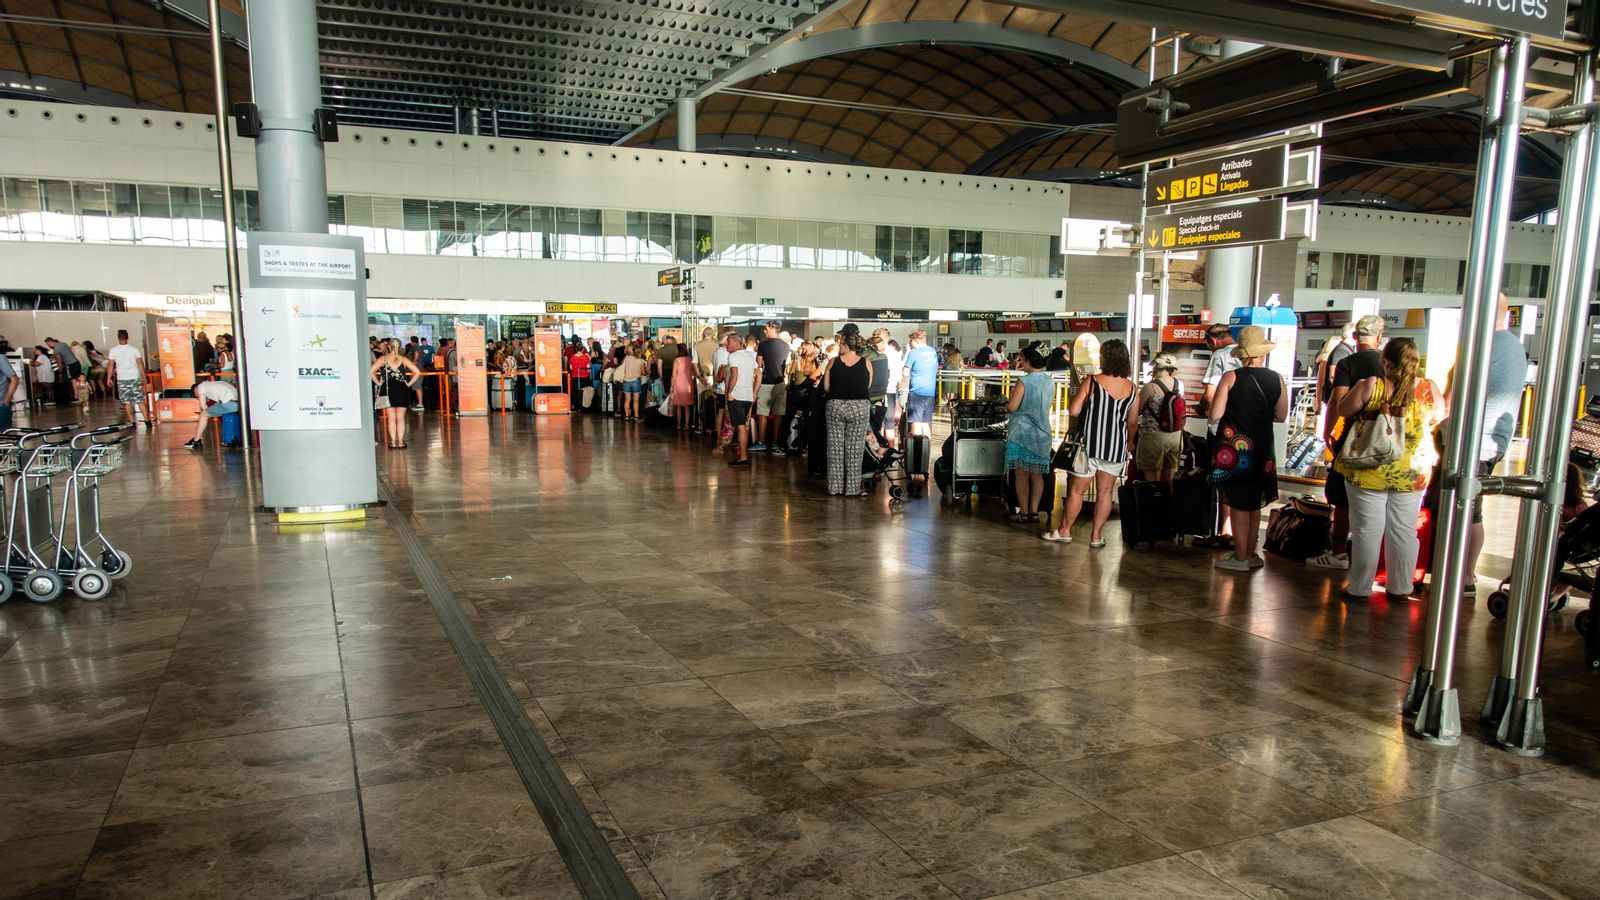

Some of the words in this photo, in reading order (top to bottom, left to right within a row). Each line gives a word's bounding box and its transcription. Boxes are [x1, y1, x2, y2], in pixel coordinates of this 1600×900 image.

[1221, 159, 1252, 171] Arribades
[1221, 171, 1241, 181] Arrivals
[1220, 180, 1248, 191] Llegadas
[1179, 215, 1212, 226] Equipatges
[1213, 210, 1243, 222] especials
[1178, 226, 1197, 235] Special
[1198, 223, 1220, 232] check-in
[1178, 235, 1207, 245] Equipajes
[1208, 230, 1241, 242] especiales
[166, 296, 216, 306] Desigual
[548, 303, 563, 311] THE
[596, 304, 616, 312] PLACE
[1173, 329, 1199, 339] SECURE
